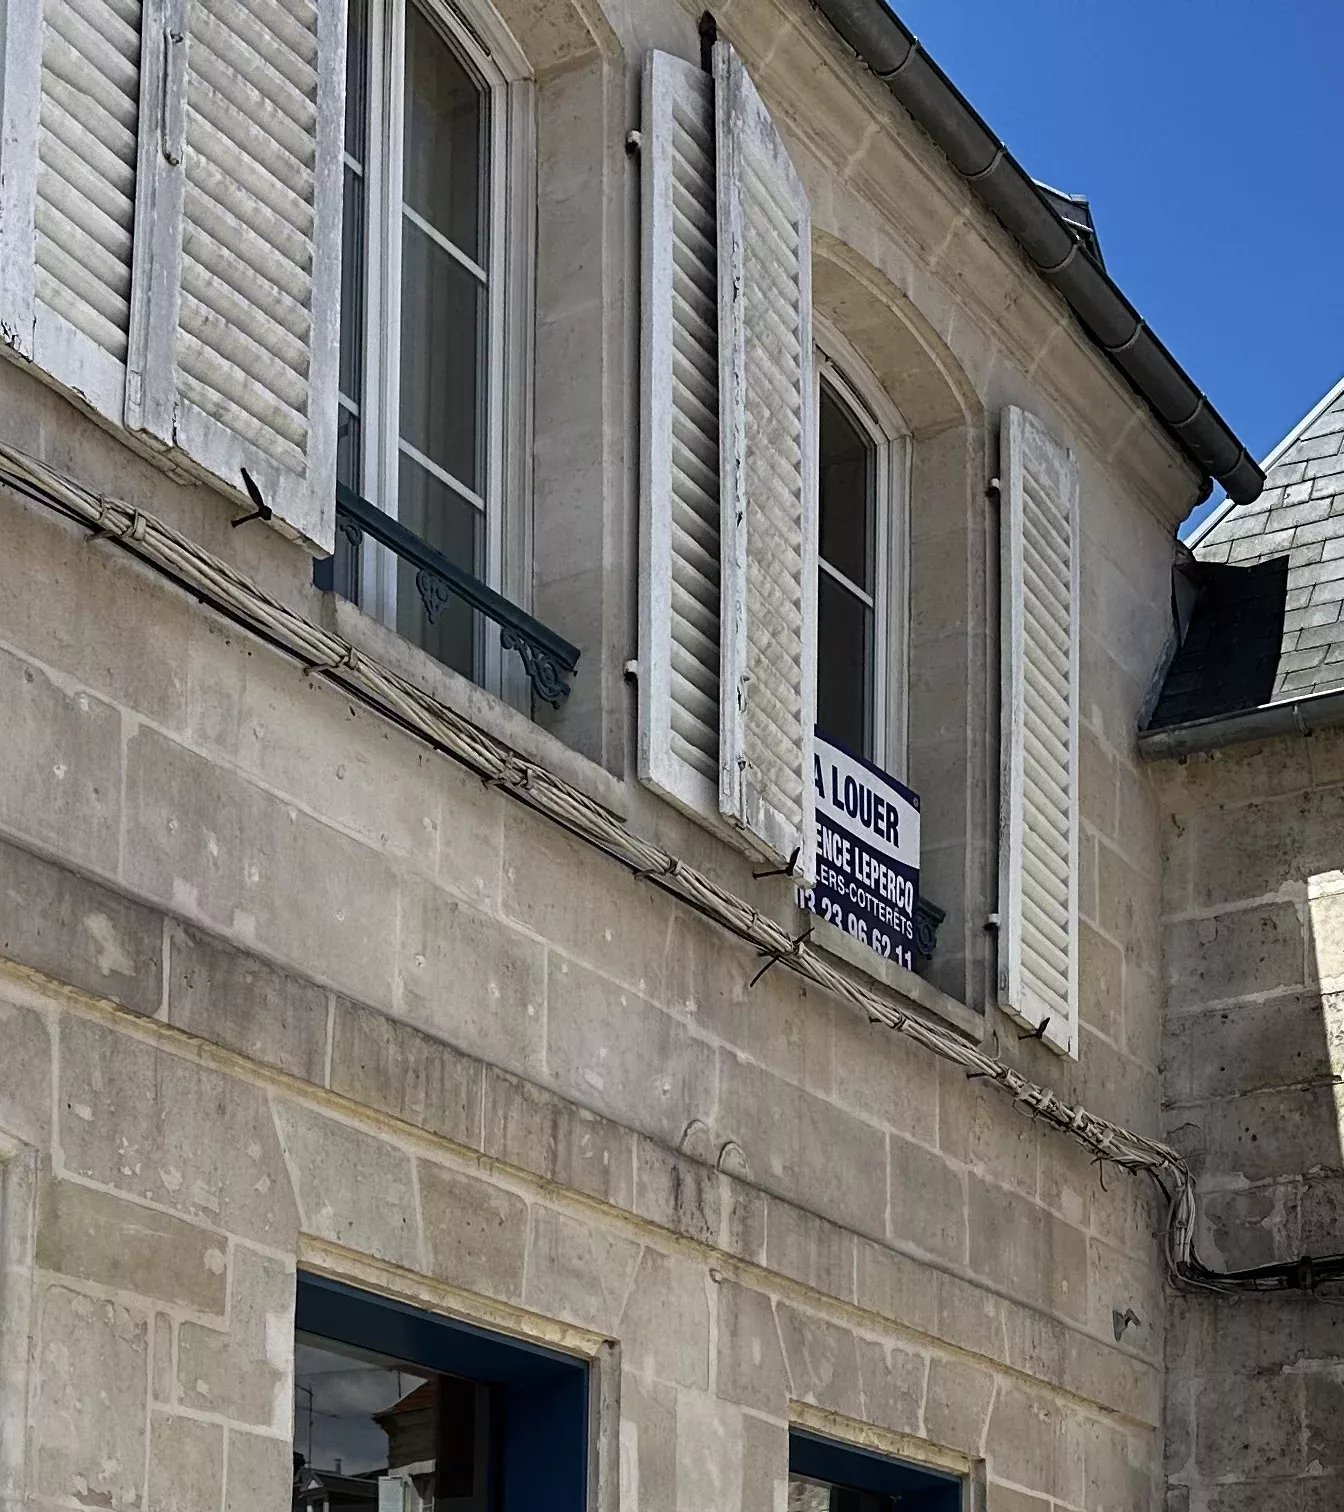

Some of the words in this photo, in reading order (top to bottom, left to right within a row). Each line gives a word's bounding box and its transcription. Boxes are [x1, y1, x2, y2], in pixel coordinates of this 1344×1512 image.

[814, 752, 825, 799] A
[831, 764, 899, 849] LOUER
[855, 847, 914, 918] LEPERCQ
